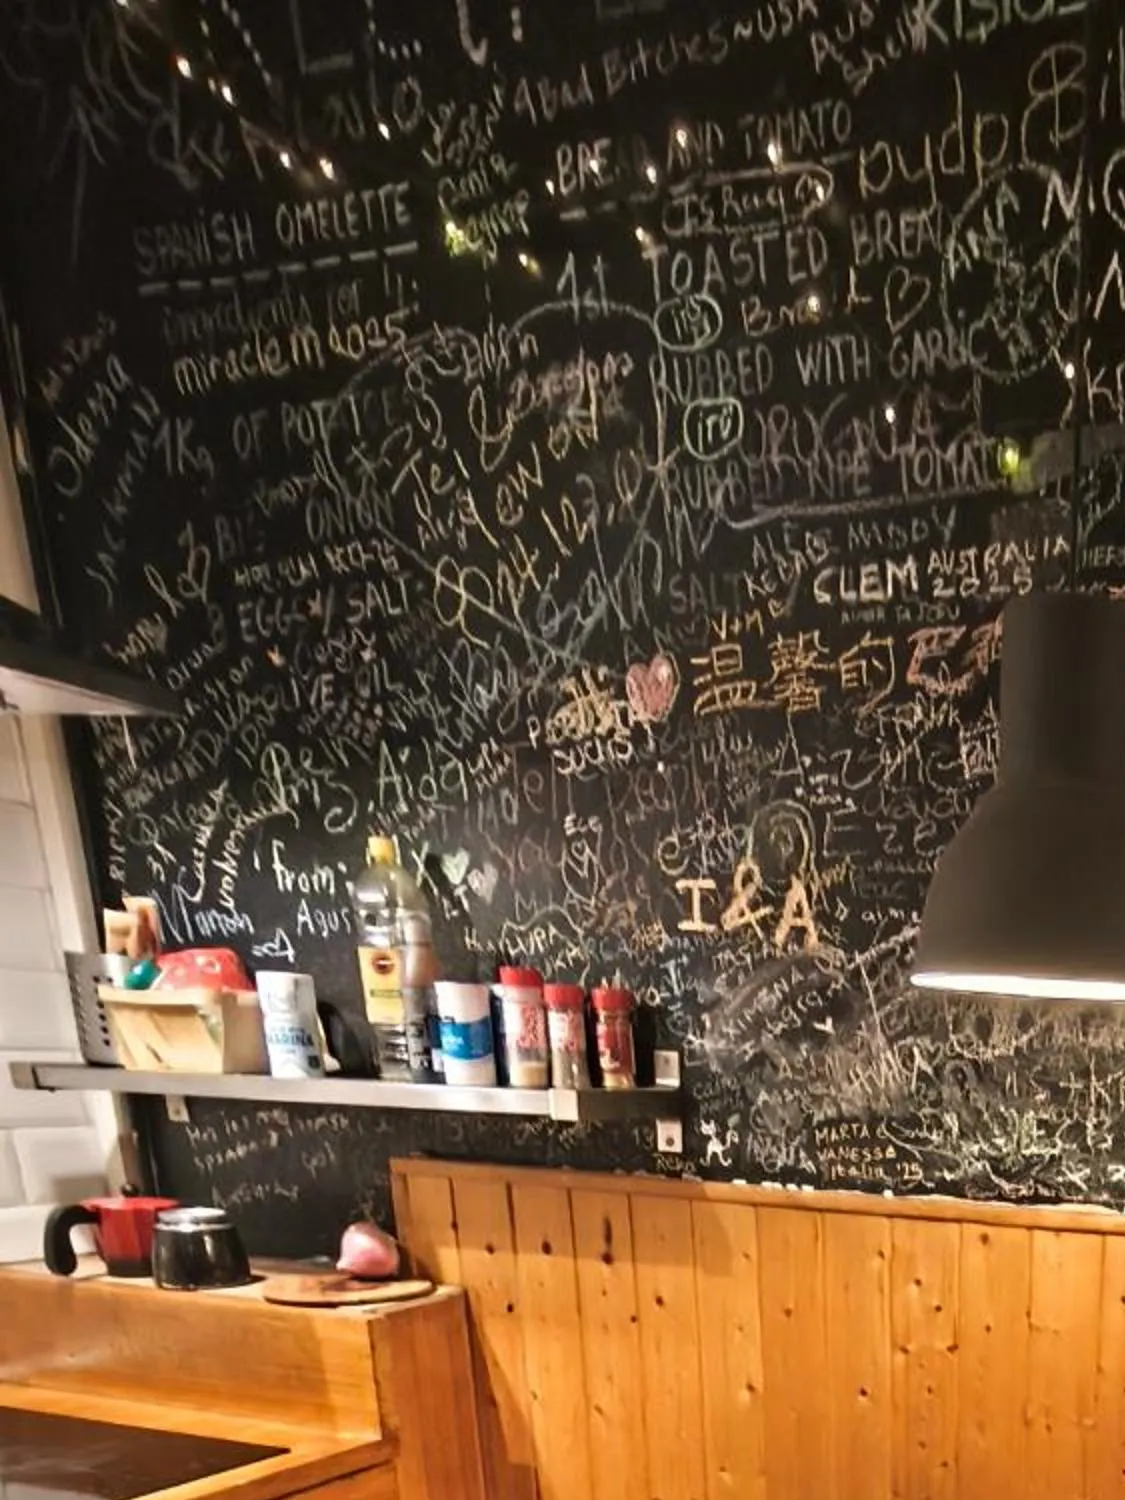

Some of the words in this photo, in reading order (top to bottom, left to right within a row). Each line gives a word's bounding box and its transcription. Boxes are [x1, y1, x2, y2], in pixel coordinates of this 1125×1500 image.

[275, 180, 413, 248] OMELETTE
[643, 222, 829, 302] TOASTED
[793, 334, 873, 388] WITH
[812, 551, 920, 607] CLEM
[927, 533, 1072, 578] AUSTRALIA
[815, 1122, 870, 1144] MARTA
